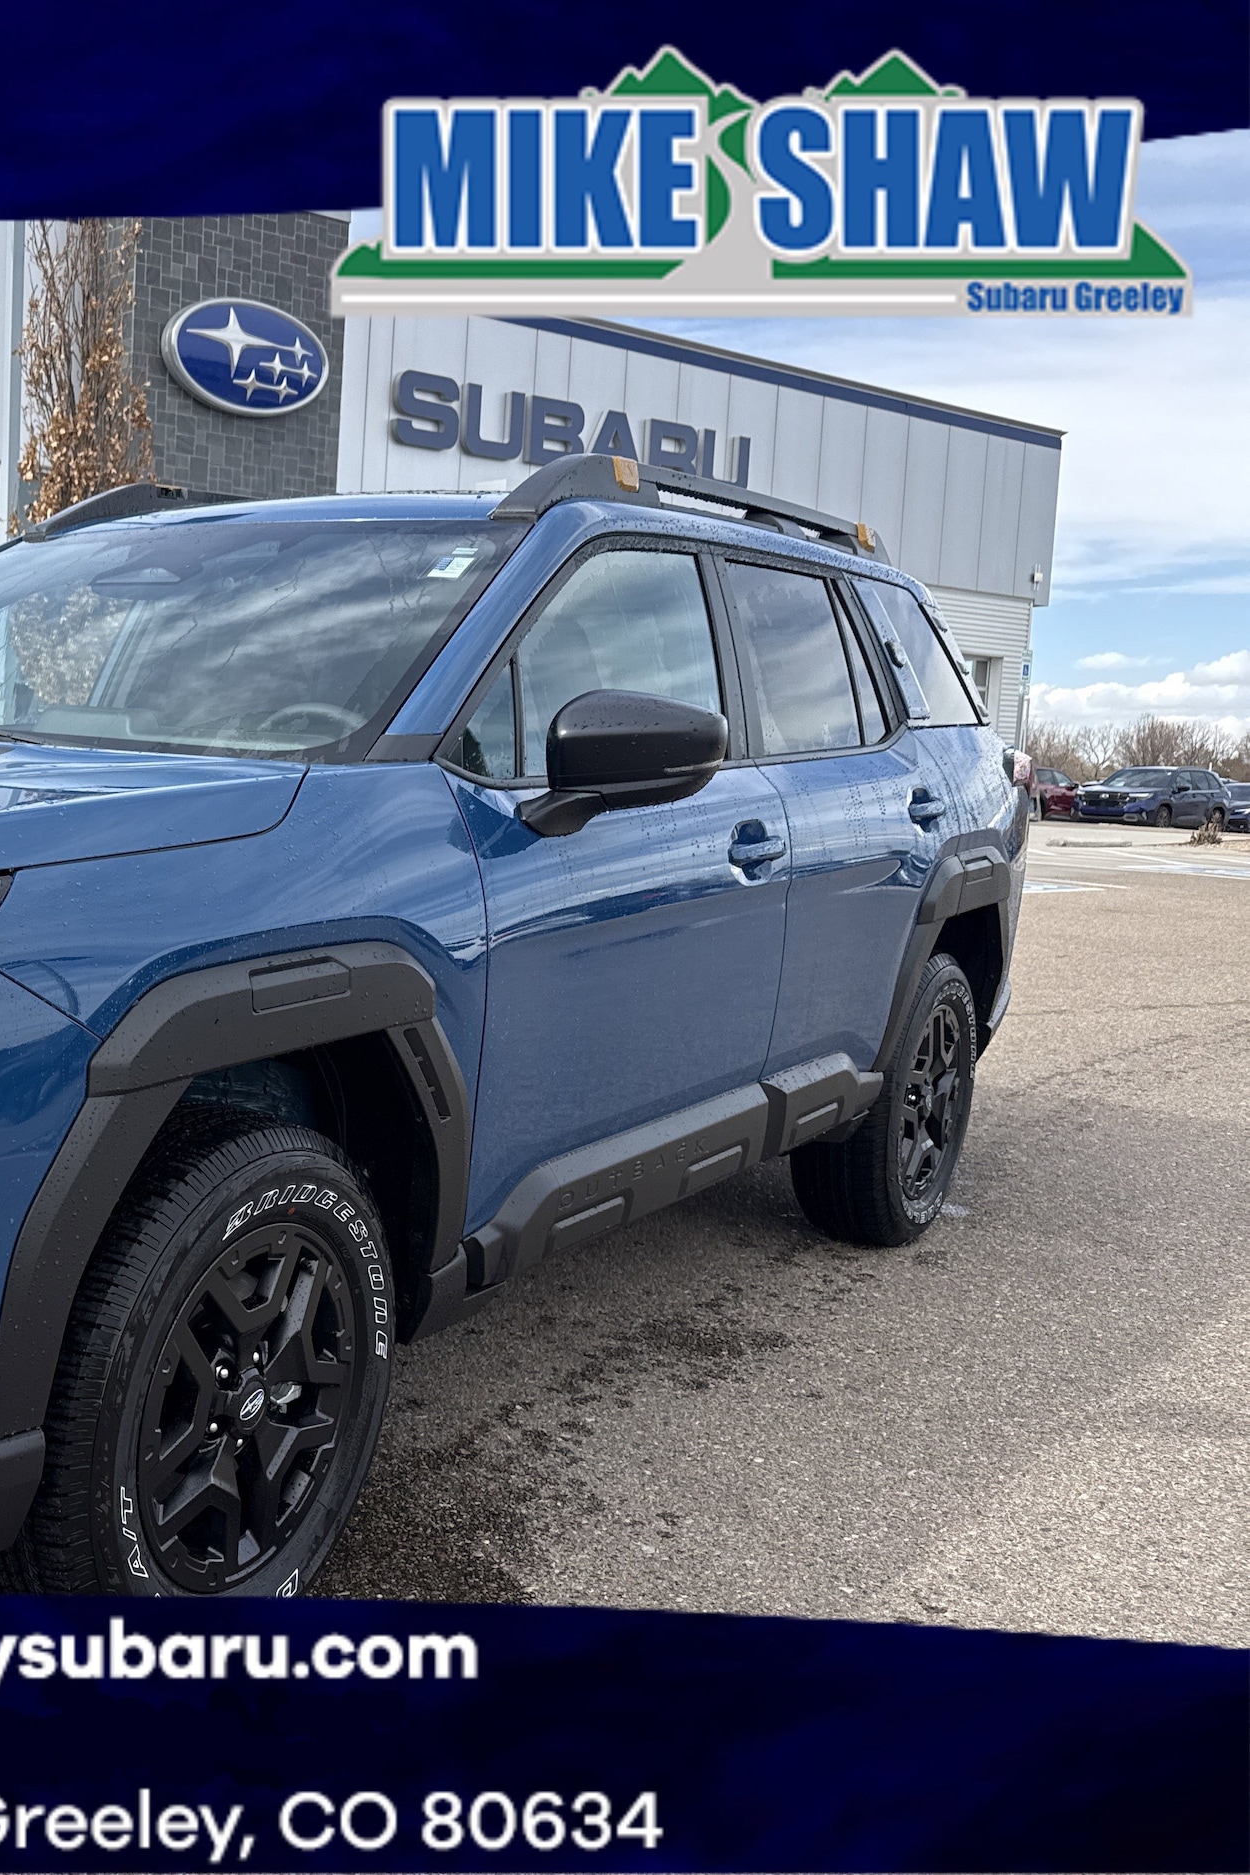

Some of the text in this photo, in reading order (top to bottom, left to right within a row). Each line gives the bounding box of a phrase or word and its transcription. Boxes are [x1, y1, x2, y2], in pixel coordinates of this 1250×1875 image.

[390, 369, 751, 490] SUBARU
[559, 1137, 710, 1211] OUTBACK
[223, 1184, 388, 1360] BRIDGESTONE
[120, 1486, 149, 1578] A/T
